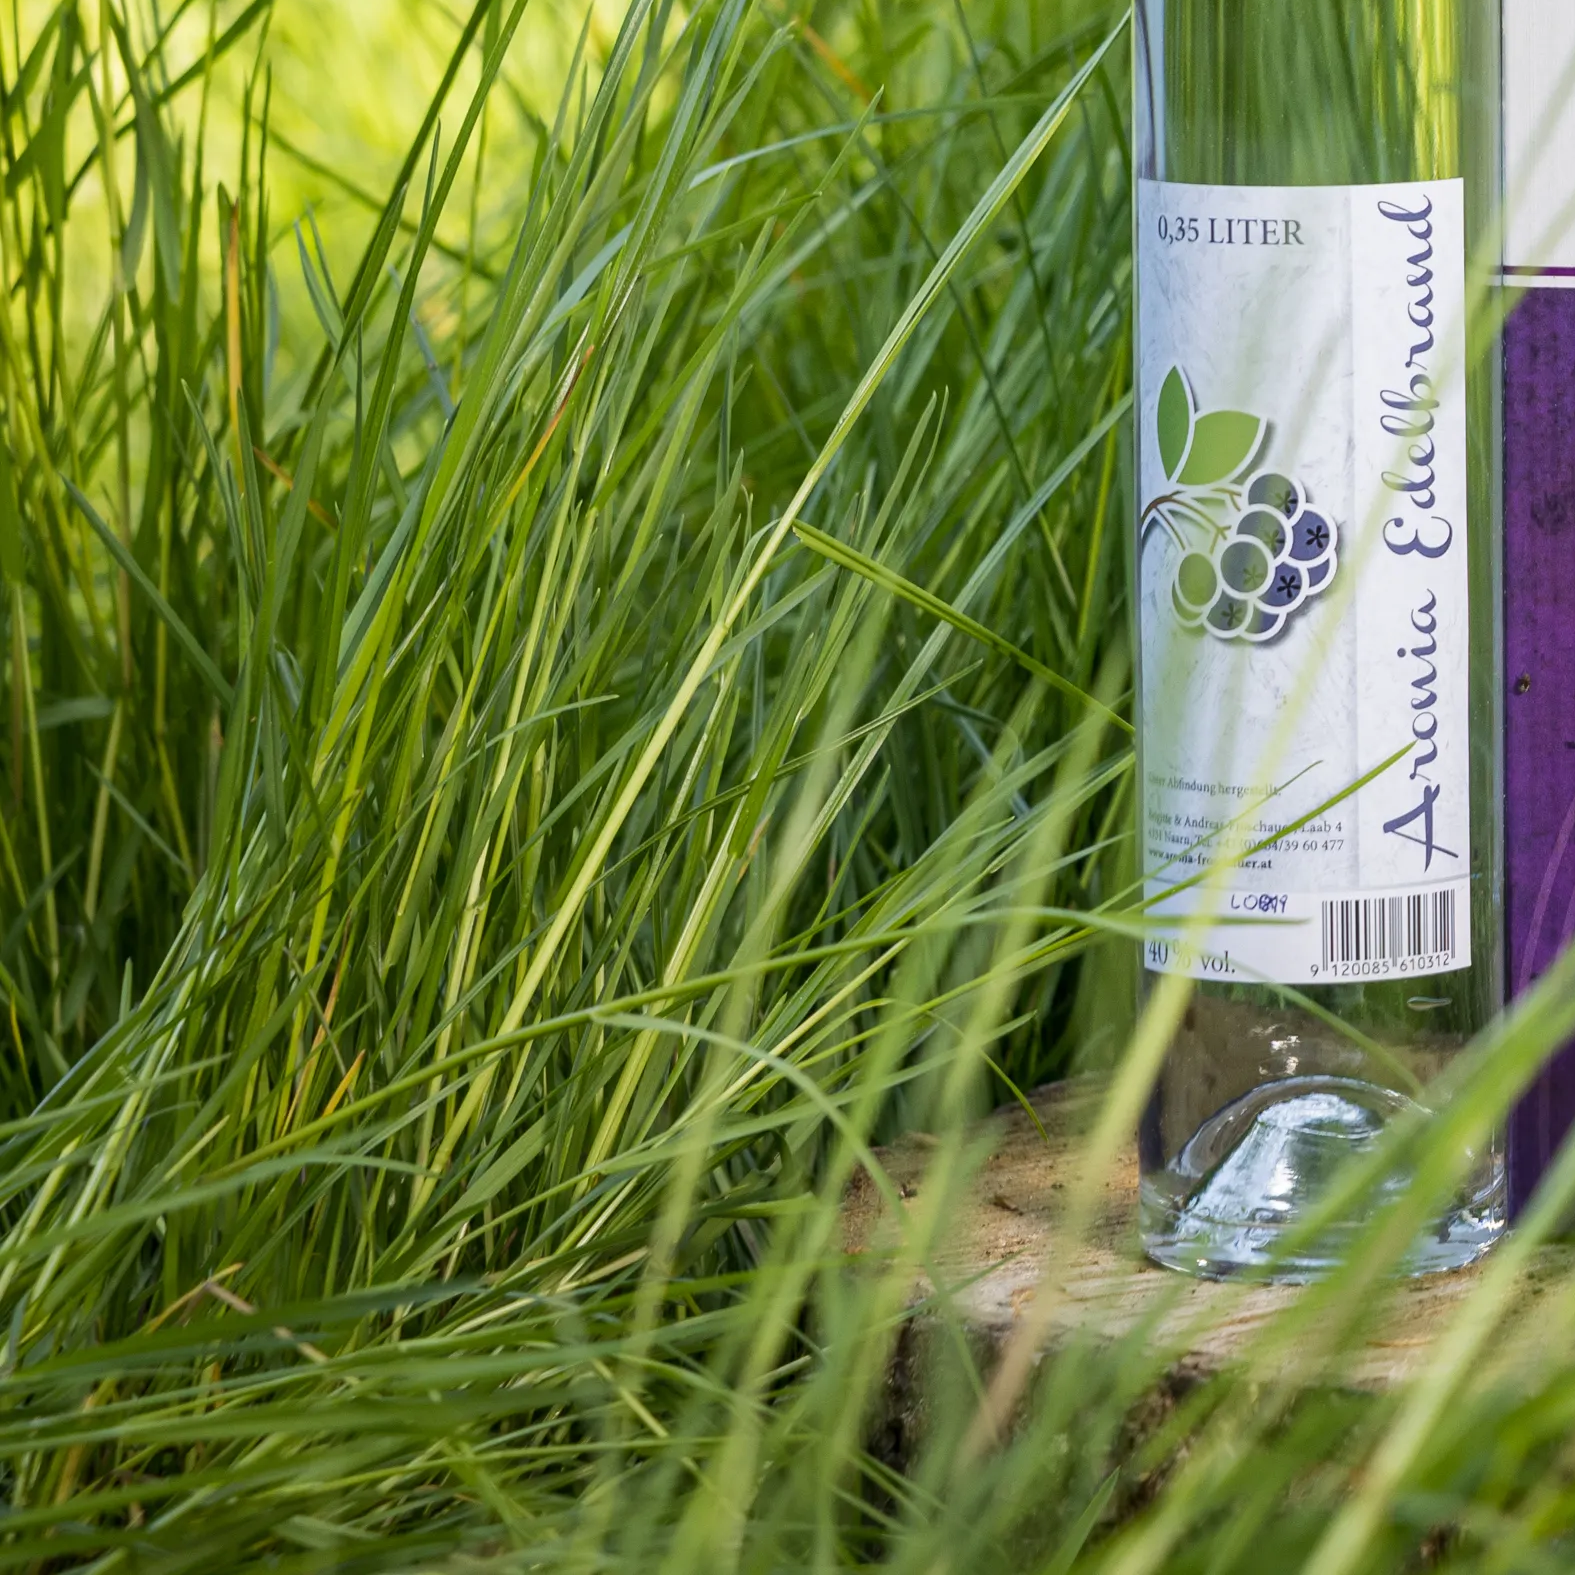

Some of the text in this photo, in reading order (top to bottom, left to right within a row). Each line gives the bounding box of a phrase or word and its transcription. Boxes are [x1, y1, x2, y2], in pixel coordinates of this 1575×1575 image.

[1158, 214, 1304, 245] 0,35 LITER
[1377, 194, 1459, 873] Aronia Edelbrand
[1167, 776, 1217, 798] Abfindung
[1174, 813, 1182, 826] &
[1302, 820, 1332, 833] Laab
[1335, 821, 1343, 833] 4
[1302, 839, 1318, 852] 60
[1321, 839, 1345, 852] 477
[1148, 940, 1169, 966] 40
[1201, 951, 1236, 974] vol.
[1310, 954, 1450, 977] 9 120085 610312
